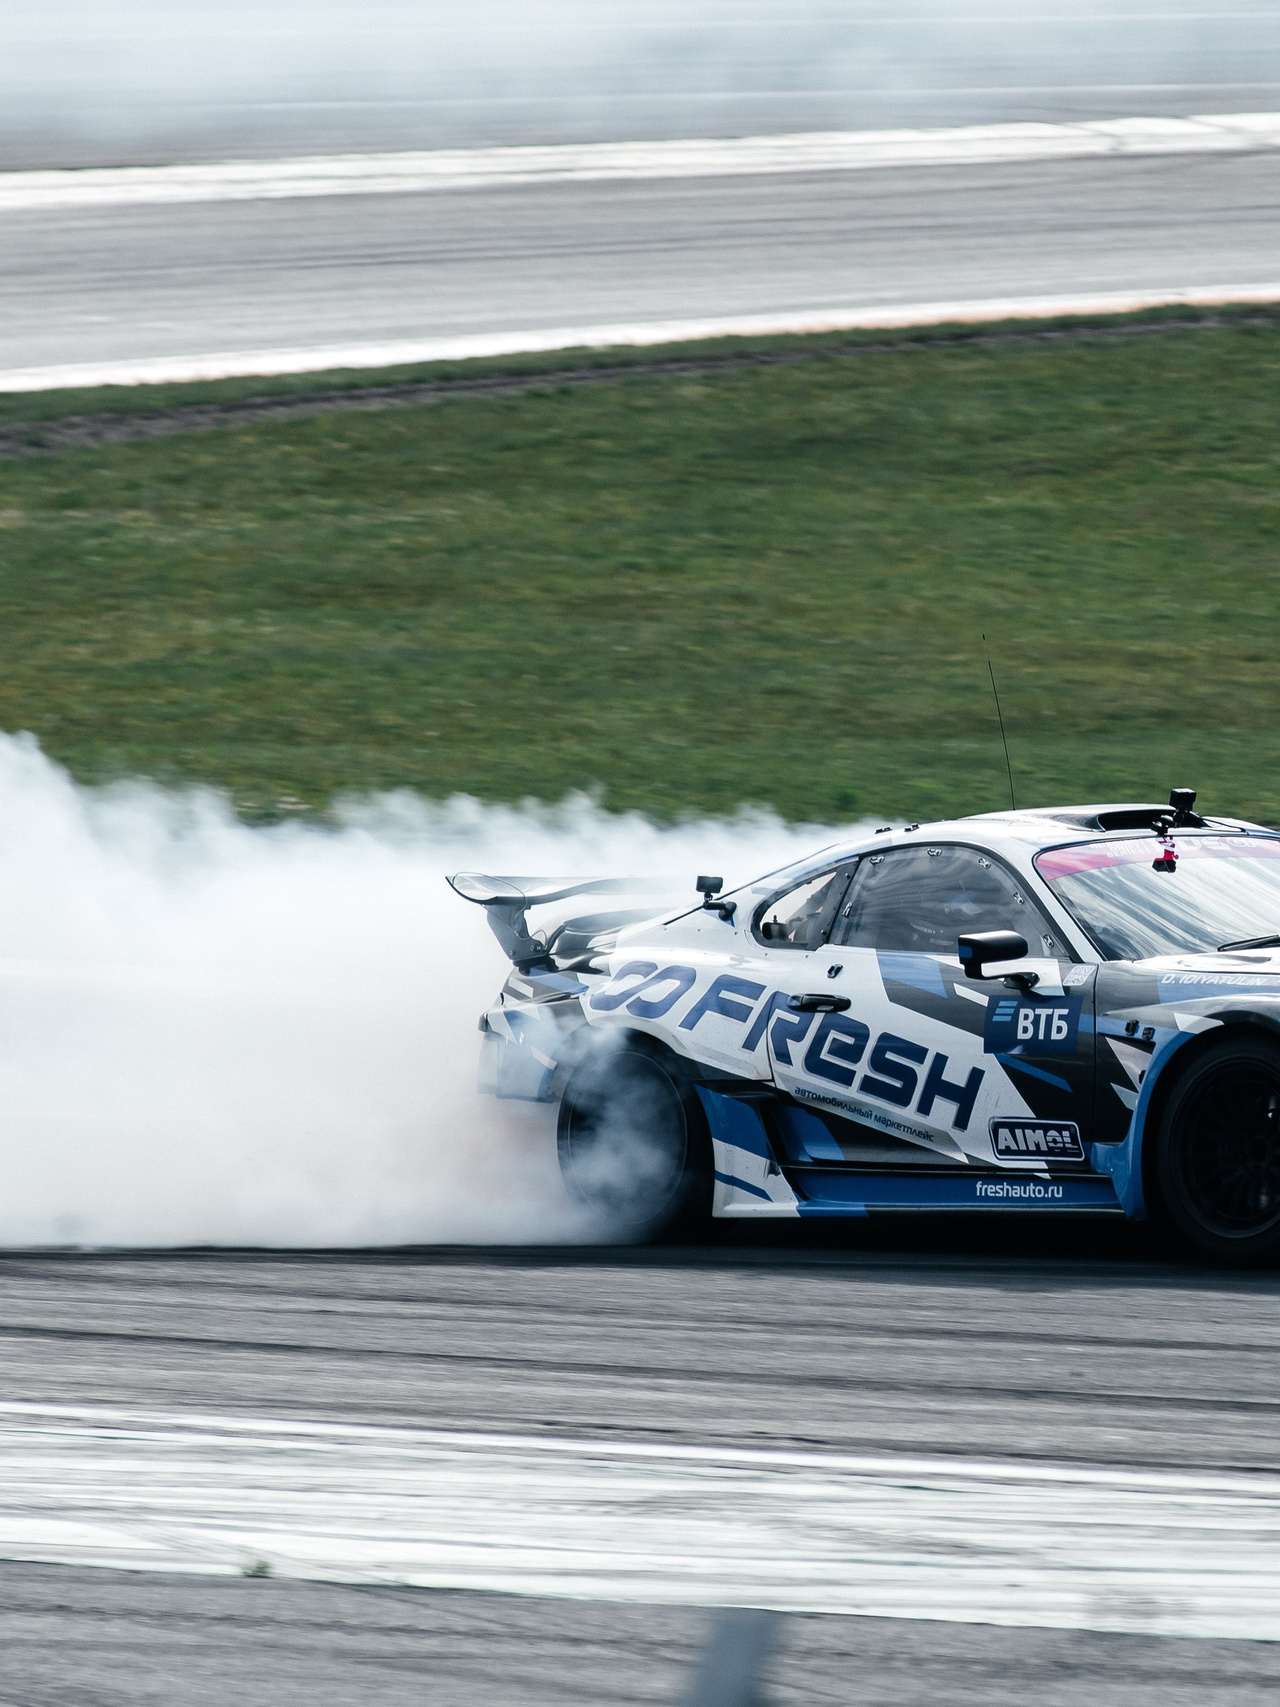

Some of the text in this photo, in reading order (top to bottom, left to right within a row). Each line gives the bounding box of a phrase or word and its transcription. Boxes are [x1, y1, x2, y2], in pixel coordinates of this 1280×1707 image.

[1179, 974, 1267, 986] IDIYATULIN
[1016, 1008, 1069, 1040] ВТБ
[794, 1086, 935, 1143] автомобильный маркетплейс
[997, 1128, 1080, 1153] AIMOL
[976, 1181, 1063, 1198] freshauto.ru
